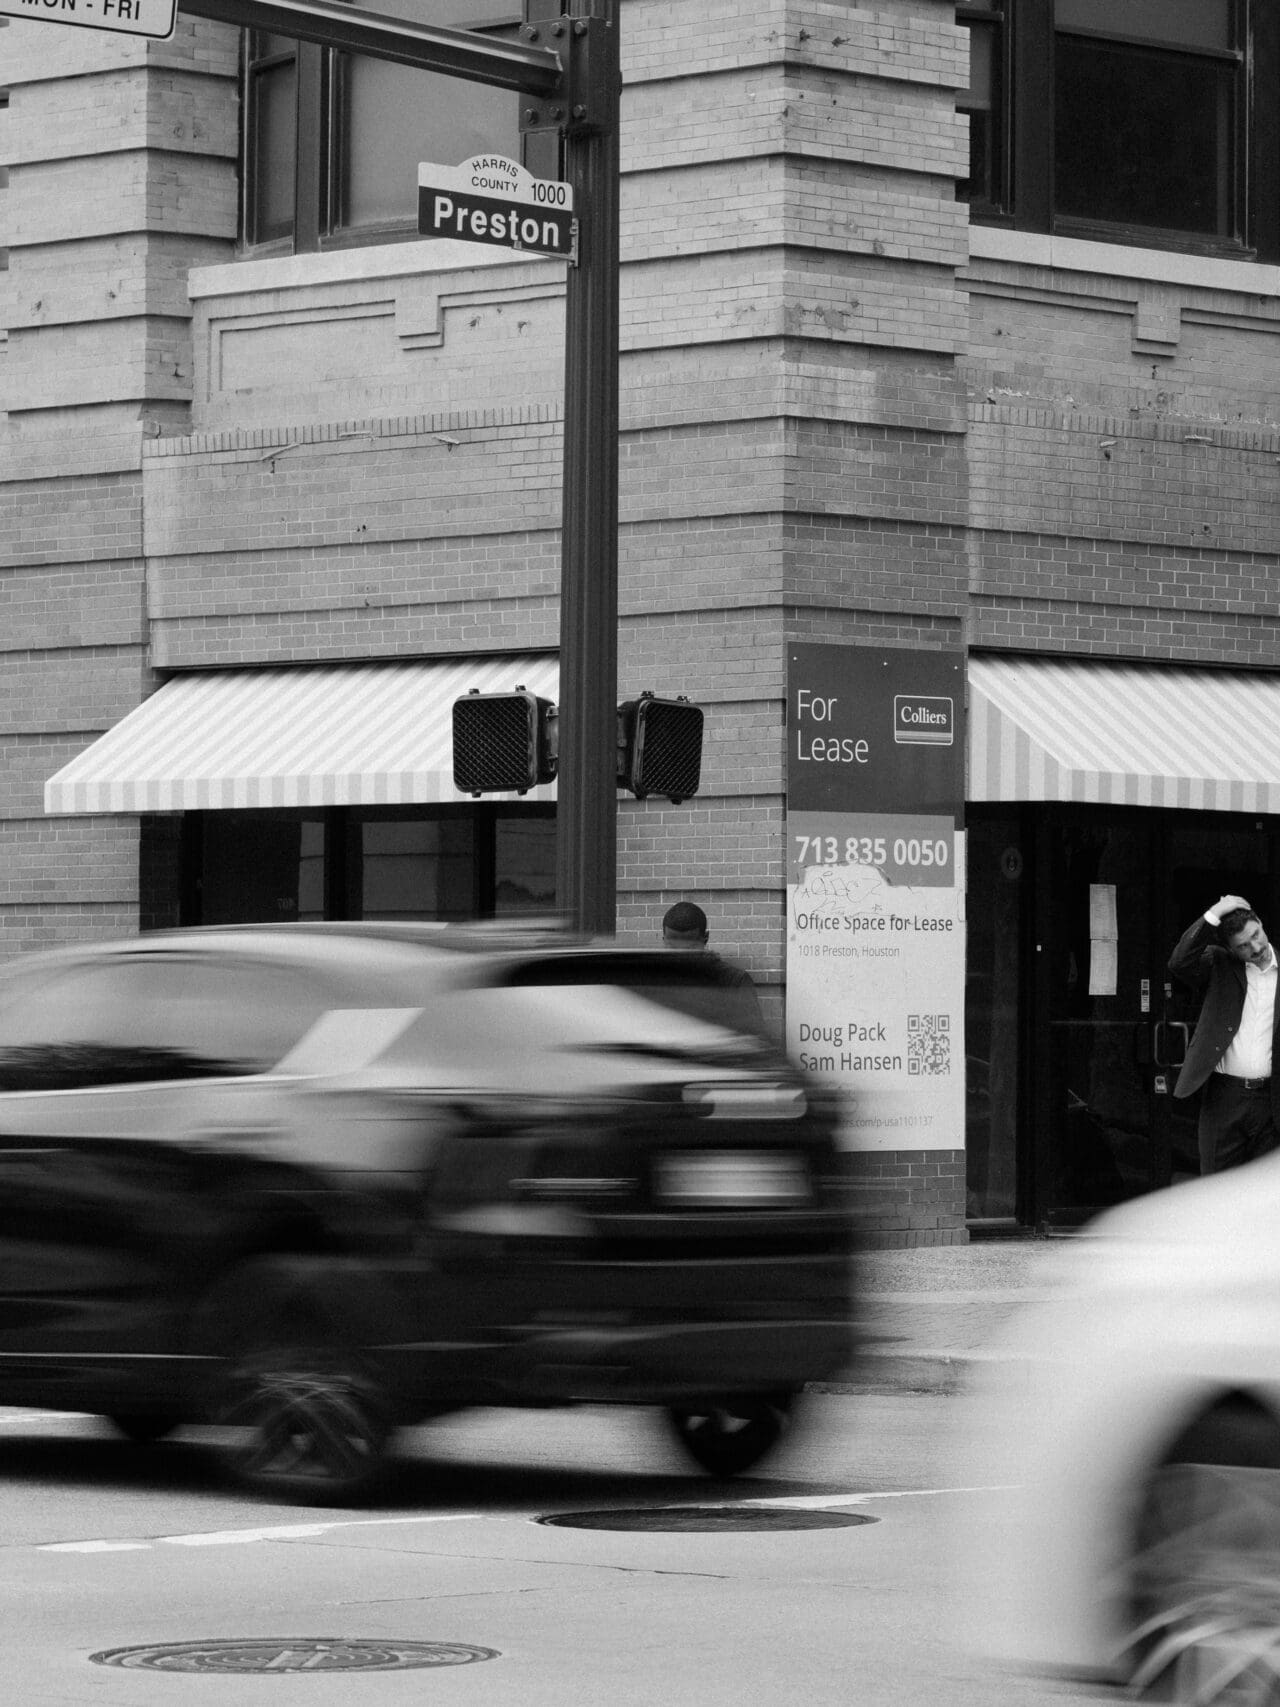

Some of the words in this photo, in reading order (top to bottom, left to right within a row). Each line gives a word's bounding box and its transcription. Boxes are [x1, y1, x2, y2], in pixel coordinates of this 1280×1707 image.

[103, 0, 140, 20] FRI
[472, 158, 519, 177] HARRIS
[471, 176, 518, 193] COUNTY
[531, 183, 566, 206] 1000
[434, 195, 560, 248] Preston
[798, 689, 837, 721] For
[900, 705, 947, 725] Colliers
[798, 729, 869, 763] Lease
[795, 836, 839, 863] 713
[845, 837, 887, 865] 835
[893, 838, 948, 866] 0050
[798, 913, 840, 931] Office
[844, 915, 886, 935] Space
[890, 914, 909, 931] for
[914, 916, 953, 931] Lease
[799, 944, 820, 957] 1018
[822, 944, 859, 959] Preston,
[862, 946, 900, 957] Houston
[799, 1023, 843, 1047] Doug
[848, 1021, 886, 1042] Pack
[799, 1052, 834, 1072] Sam
[841, 1052, 902, 1071] Hansen
